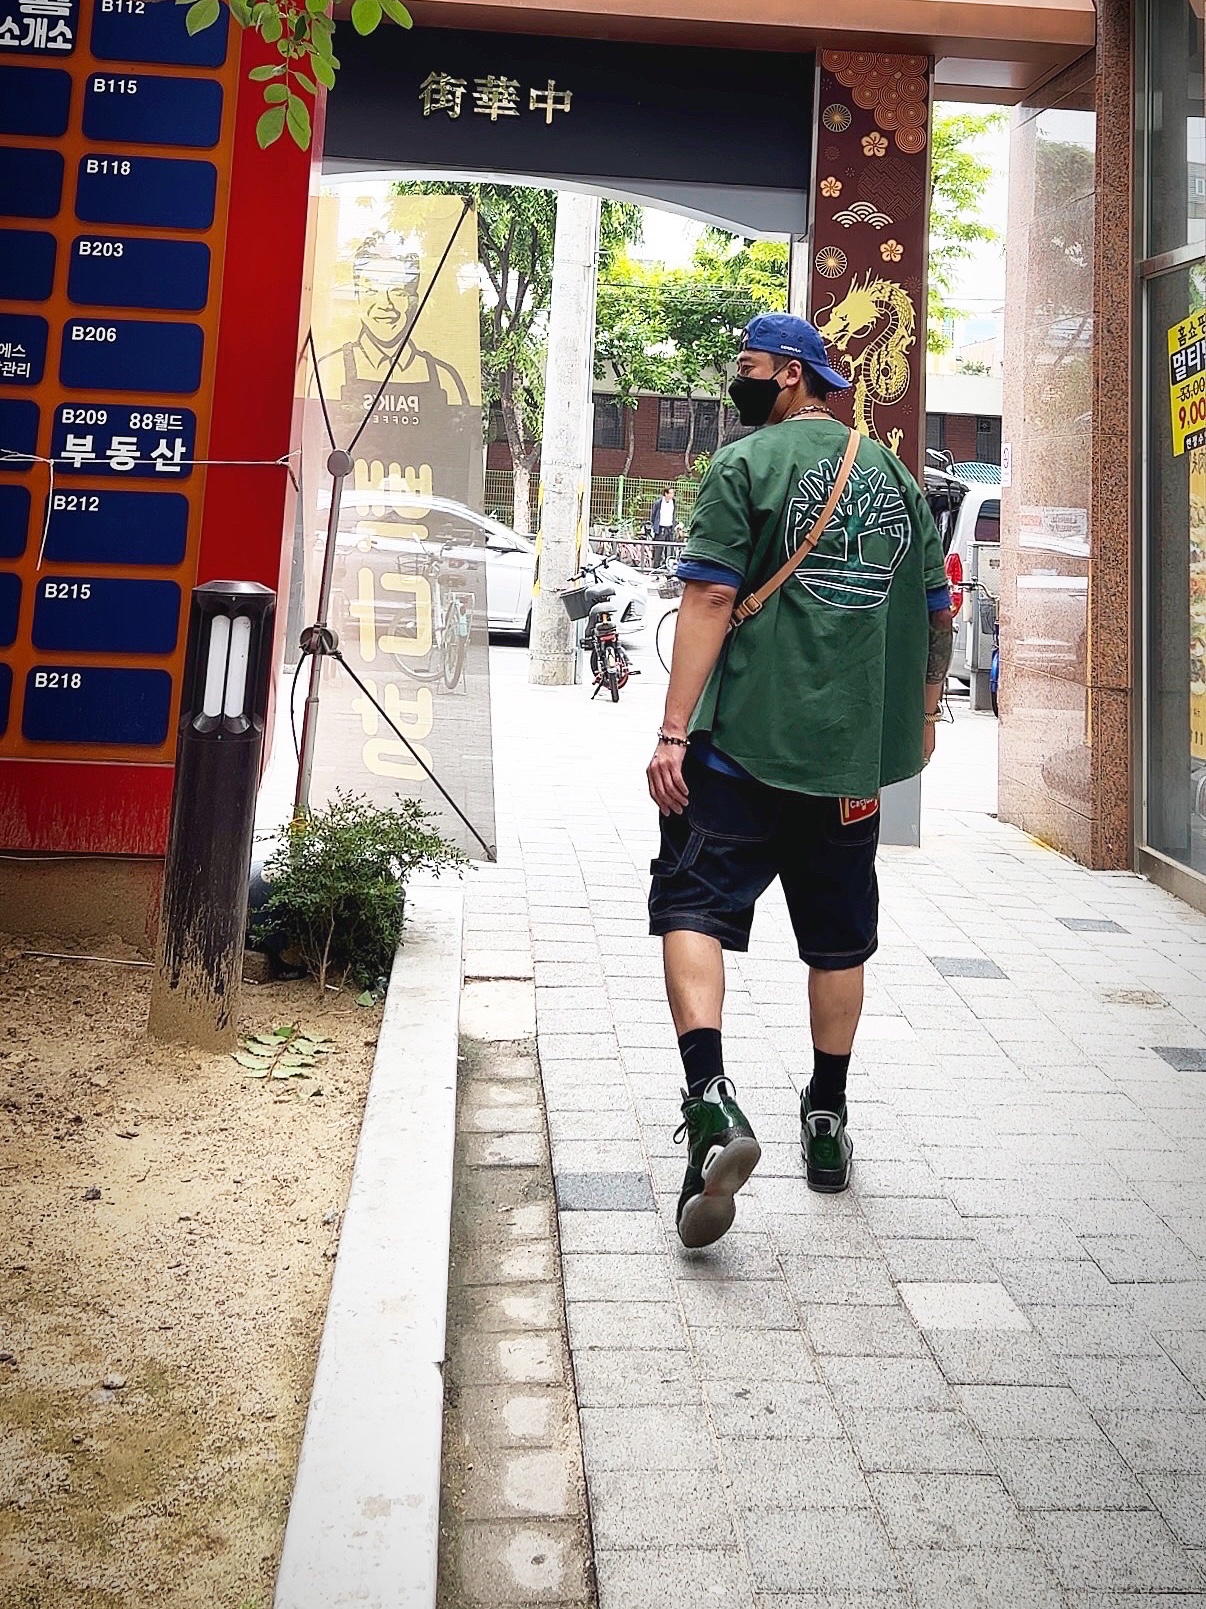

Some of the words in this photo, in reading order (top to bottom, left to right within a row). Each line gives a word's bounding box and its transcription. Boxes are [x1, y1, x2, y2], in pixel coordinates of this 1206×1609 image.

[101, 0, 145, 14] B112
[0, 15, 73, 50] 소개소
[93, 78, 138, 95] B115
[86, 159, 131, 175] B118
[79, 241, 124, 257] B203
[71, 326, 117, 342] B206
[1172, 340, 1206, 381] 멀티
[0, 361, 31, 378] 관리
[62, 409, 107, 425] B209
[129, 413, 183, 431] 88월드
[61, 434, 186, 472] 부동산
[54, 496, 99, 512] B212
[45, 584, 91, 600] B215
[35, 673, 81, 689] B218
